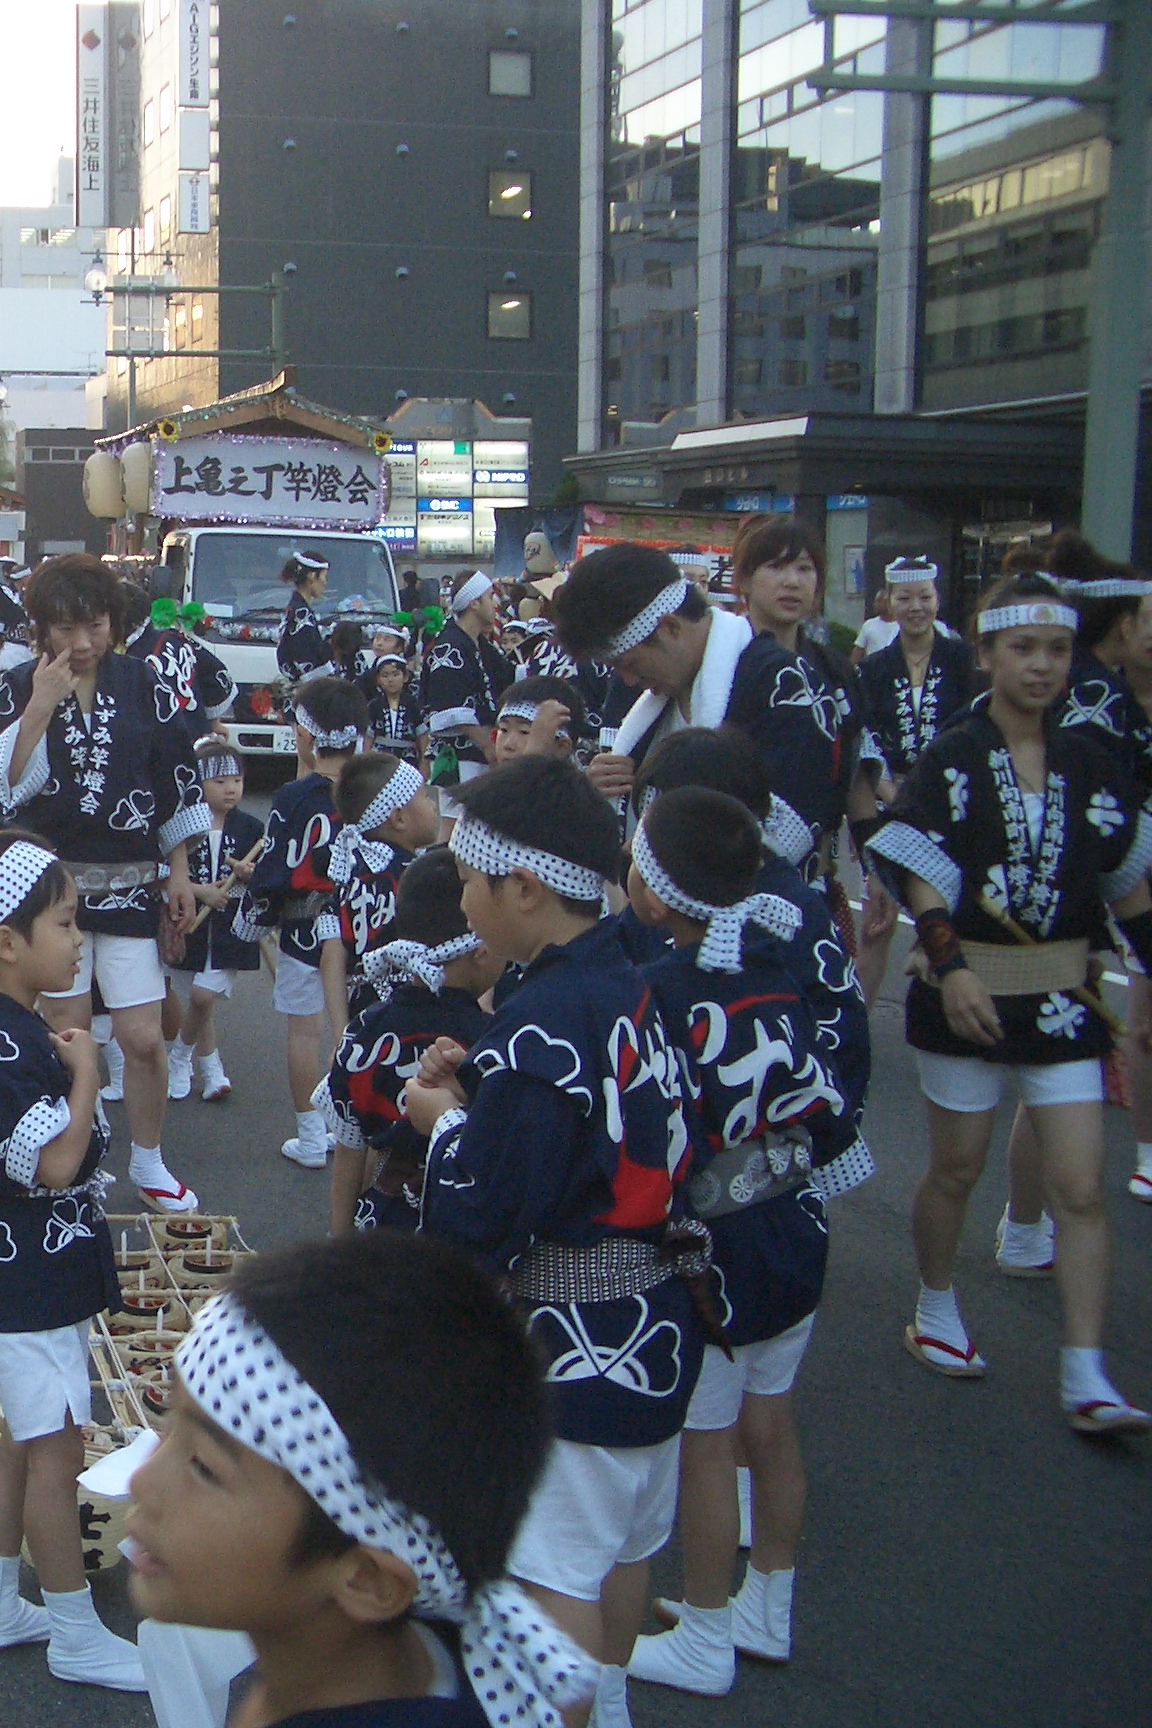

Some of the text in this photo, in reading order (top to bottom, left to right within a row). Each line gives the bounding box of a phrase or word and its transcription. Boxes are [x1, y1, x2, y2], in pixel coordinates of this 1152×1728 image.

[82, 78, 100, 191] 三井住友海上
[161, 456, 378, 506] 上亀之丁竿燈会
[79, 691, 117, 816] いずみ竿燈会
